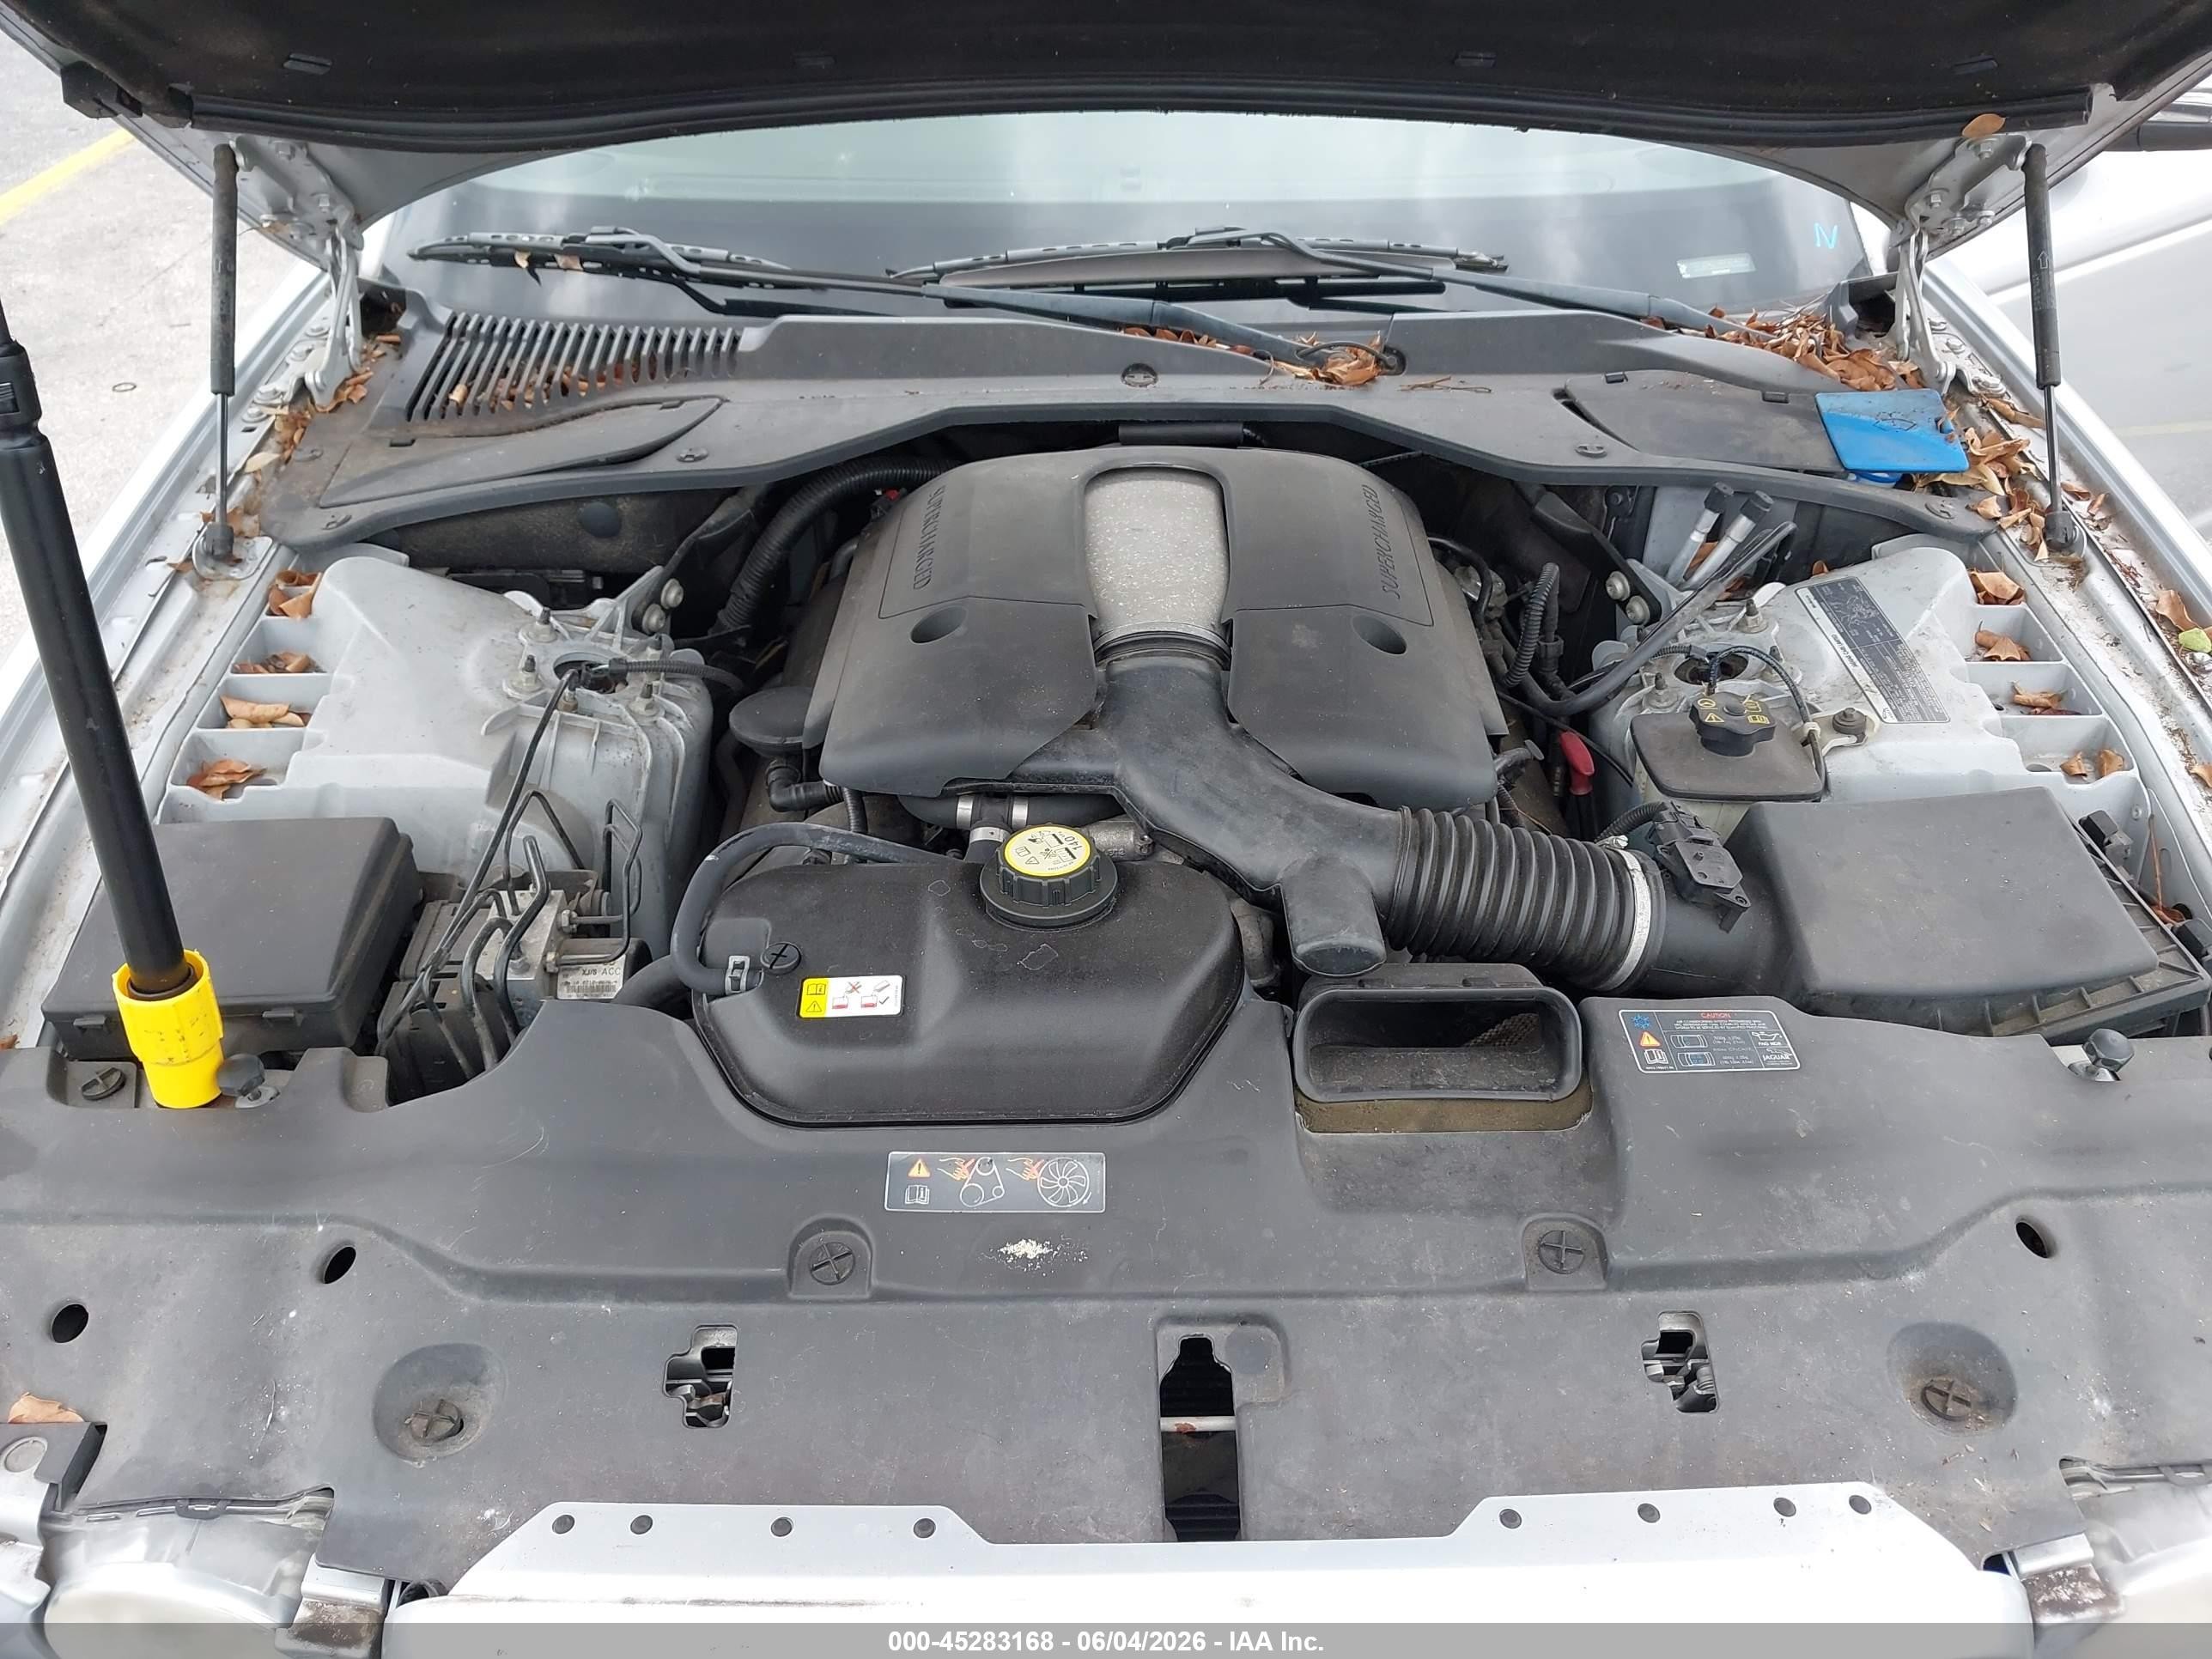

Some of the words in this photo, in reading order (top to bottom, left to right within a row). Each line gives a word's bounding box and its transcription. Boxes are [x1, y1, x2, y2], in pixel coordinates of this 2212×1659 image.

[913, 484, 946, 590] SUPERCHARGED
[1361, 484, 1401, 600] SUPERCHARGED
[1064, 836, 1084, 851] 140
